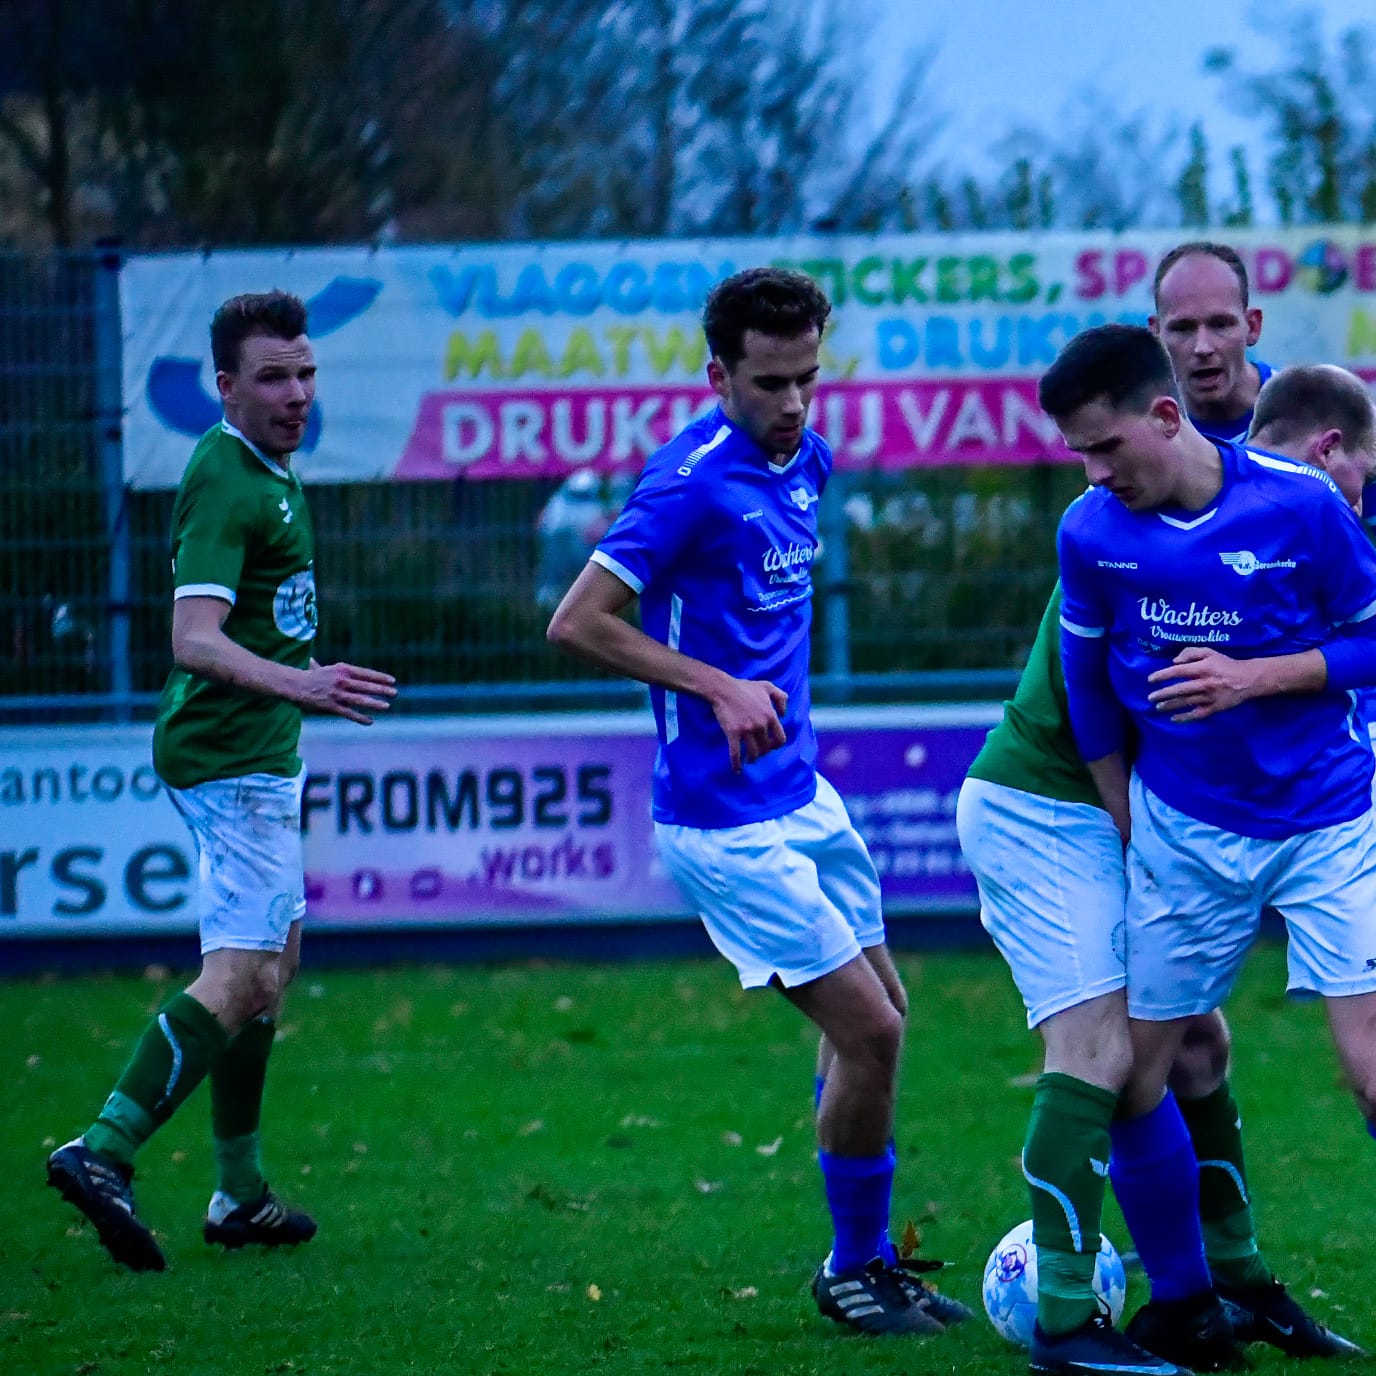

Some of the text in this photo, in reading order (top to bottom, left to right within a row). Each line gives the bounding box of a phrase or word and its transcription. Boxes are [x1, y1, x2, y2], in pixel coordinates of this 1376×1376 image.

[771, 253, 1063, 306] TICKERS,
[1136, 596, 1244, 627] Wachters
[1149, 624, 1231, 645] Vrouwenpolder
[300, 766, 612, 835] FROM925
